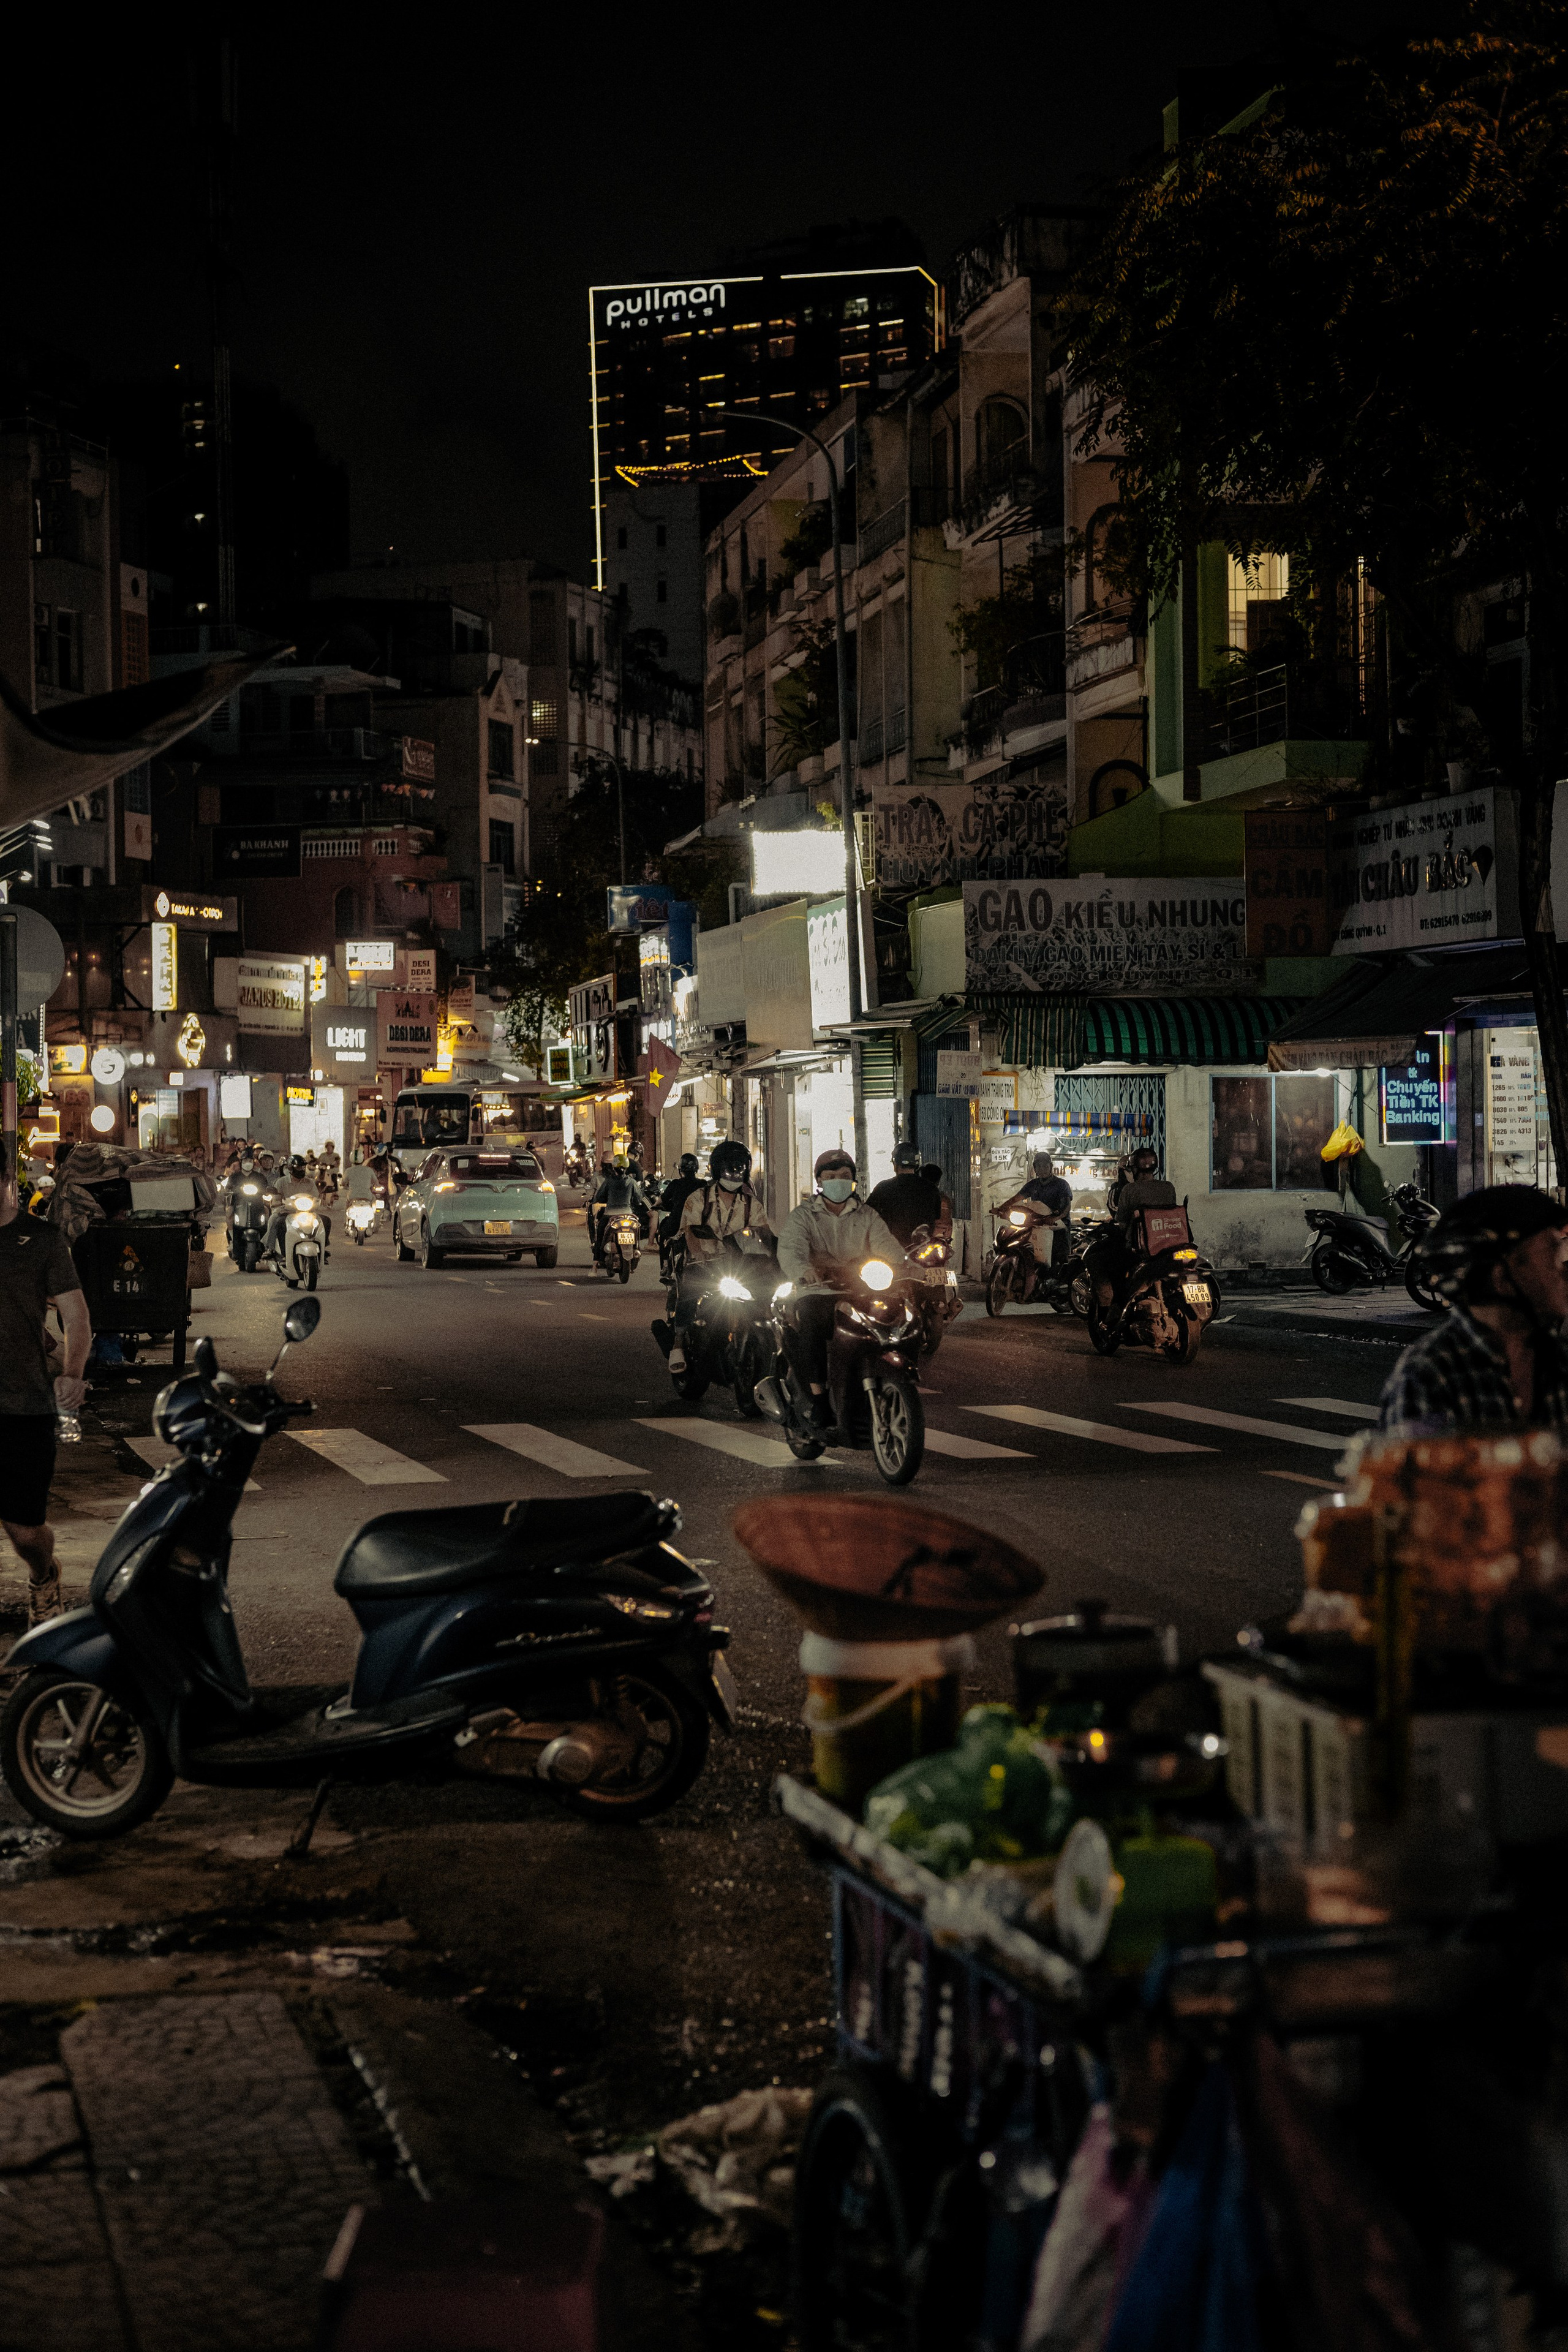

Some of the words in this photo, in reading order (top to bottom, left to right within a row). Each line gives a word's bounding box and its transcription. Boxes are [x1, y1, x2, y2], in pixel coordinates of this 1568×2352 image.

[606, 284, 726, 326] pullman
[620, 307, 714, 330] HOTELS
[1465, 801, 1485, 826] VÀNG
[1361, 850, 1419, 902] CHÂU
[1148, 899, 1246, 927] NHUNG
[1211, 943, 1225, 959] &
[326, 1027, 366, 1049] LIGHT
[1419, 1095, 1439, 1107] TK
[1385, 1110, 1439, 1126] Banking
[1186, 1293, 1210, 1302] 450.89
